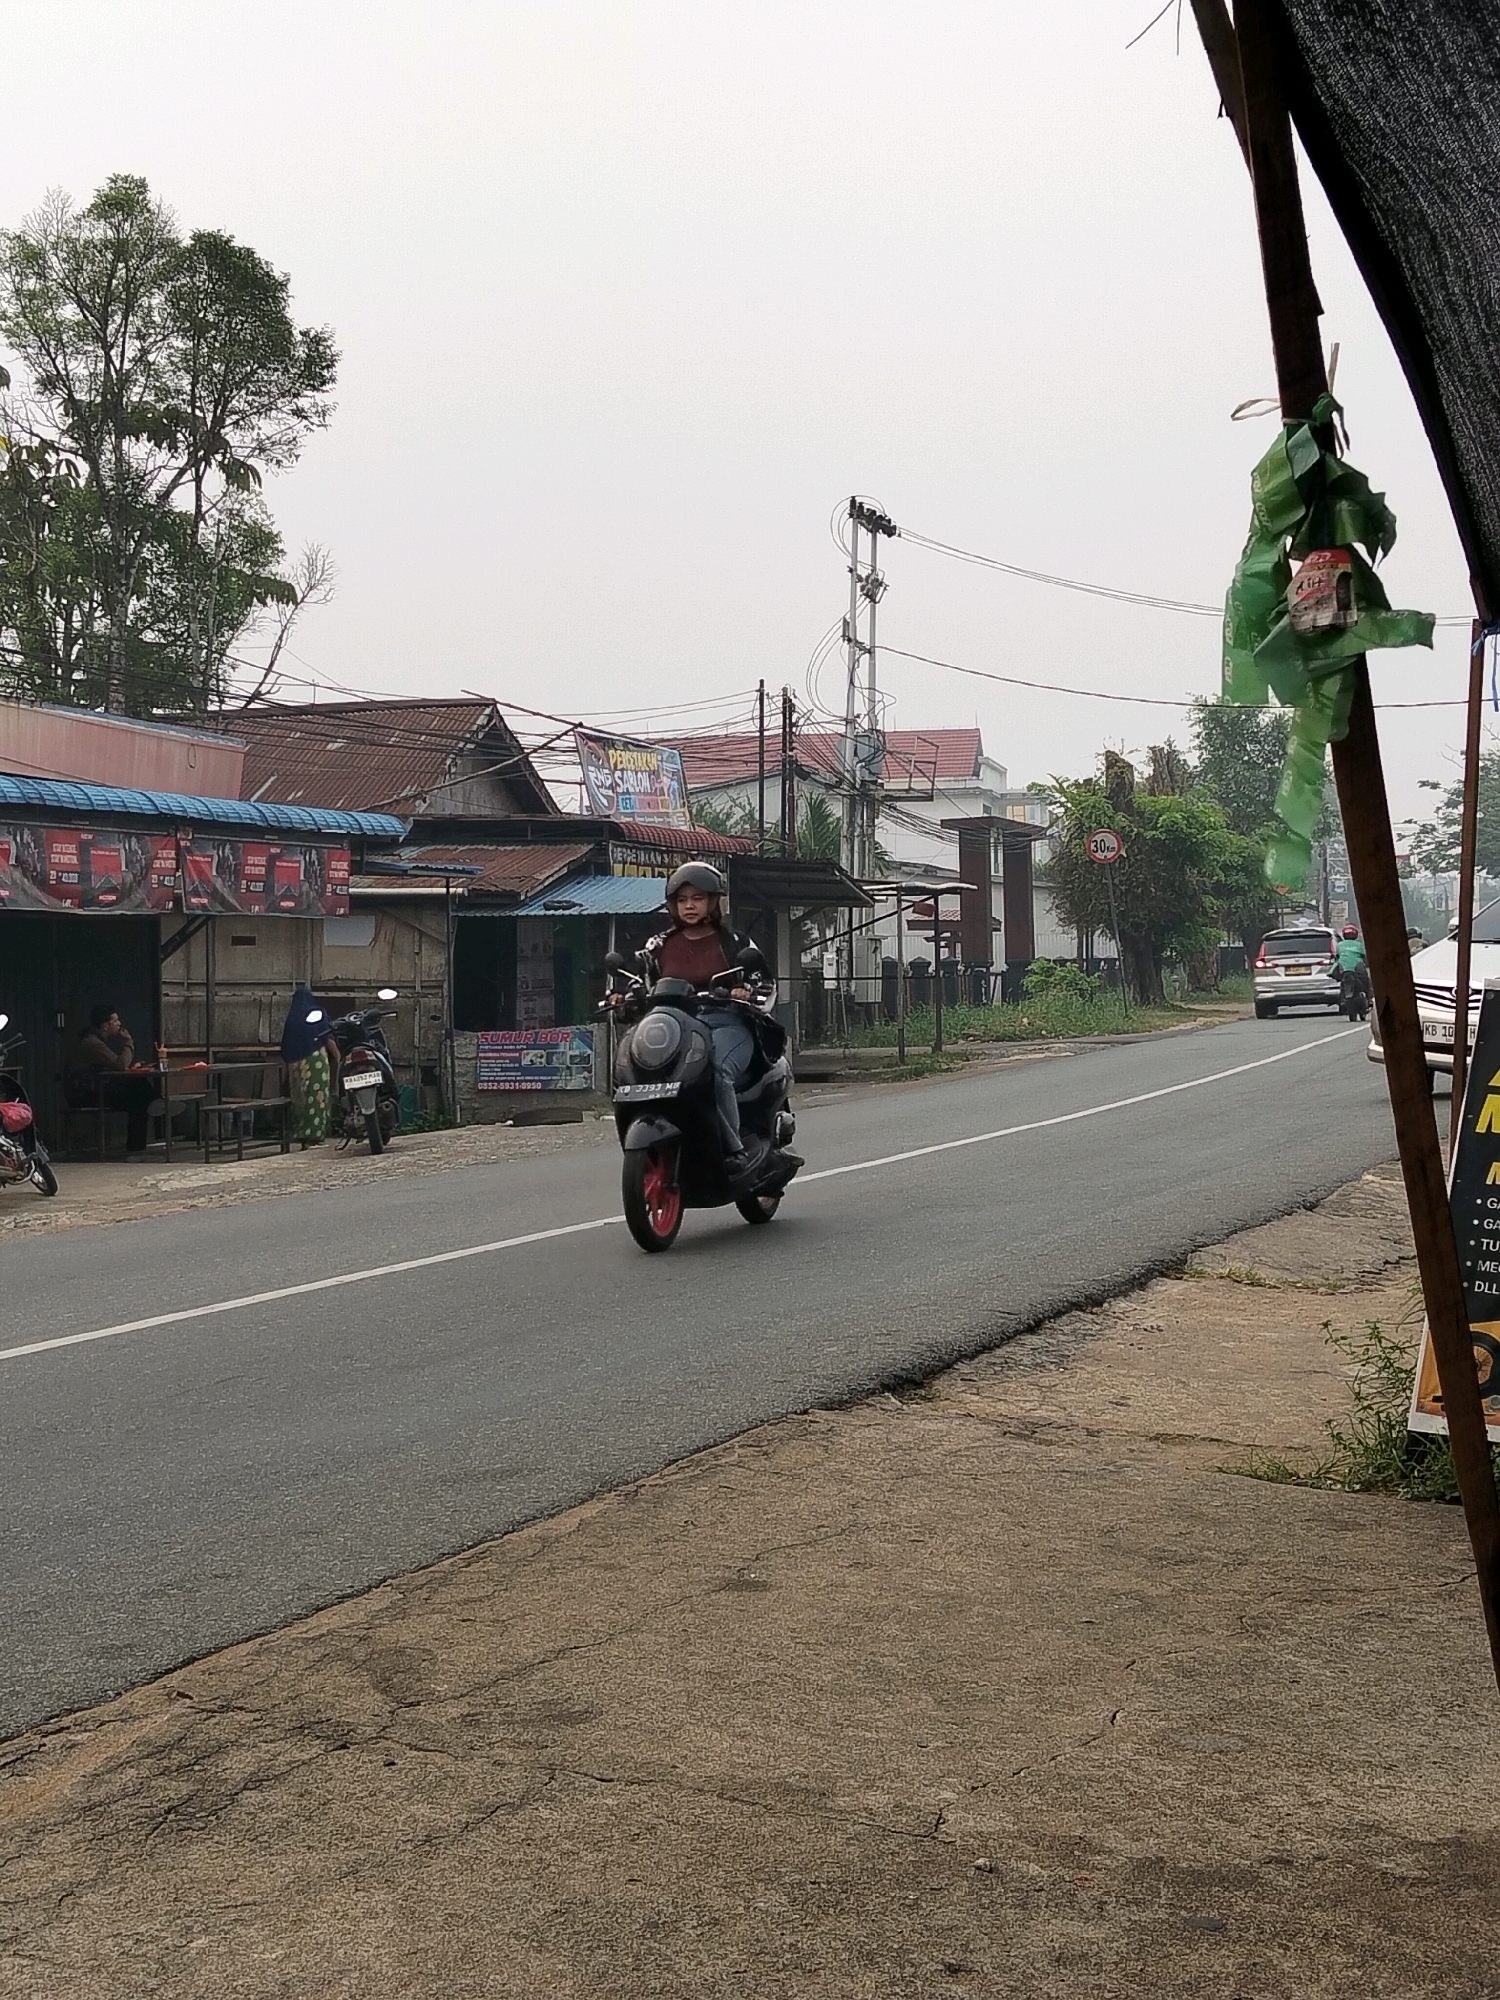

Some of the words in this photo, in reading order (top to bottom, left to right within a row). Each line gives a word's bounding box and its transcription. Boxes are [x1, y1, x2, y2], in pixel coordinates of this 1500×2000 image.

[614, 770, 651, 793] SABLON
[1092, 839, 1106, 853] 30
[479, 1031, 535, 1044] SUMUR
[537, 1030, 572, 1044] BOR
[1425, 1024, 1438, 1036] KB
[1486, 1197, 1500, 1209] G
[1474, 1280, 1500, 1294] DLL
